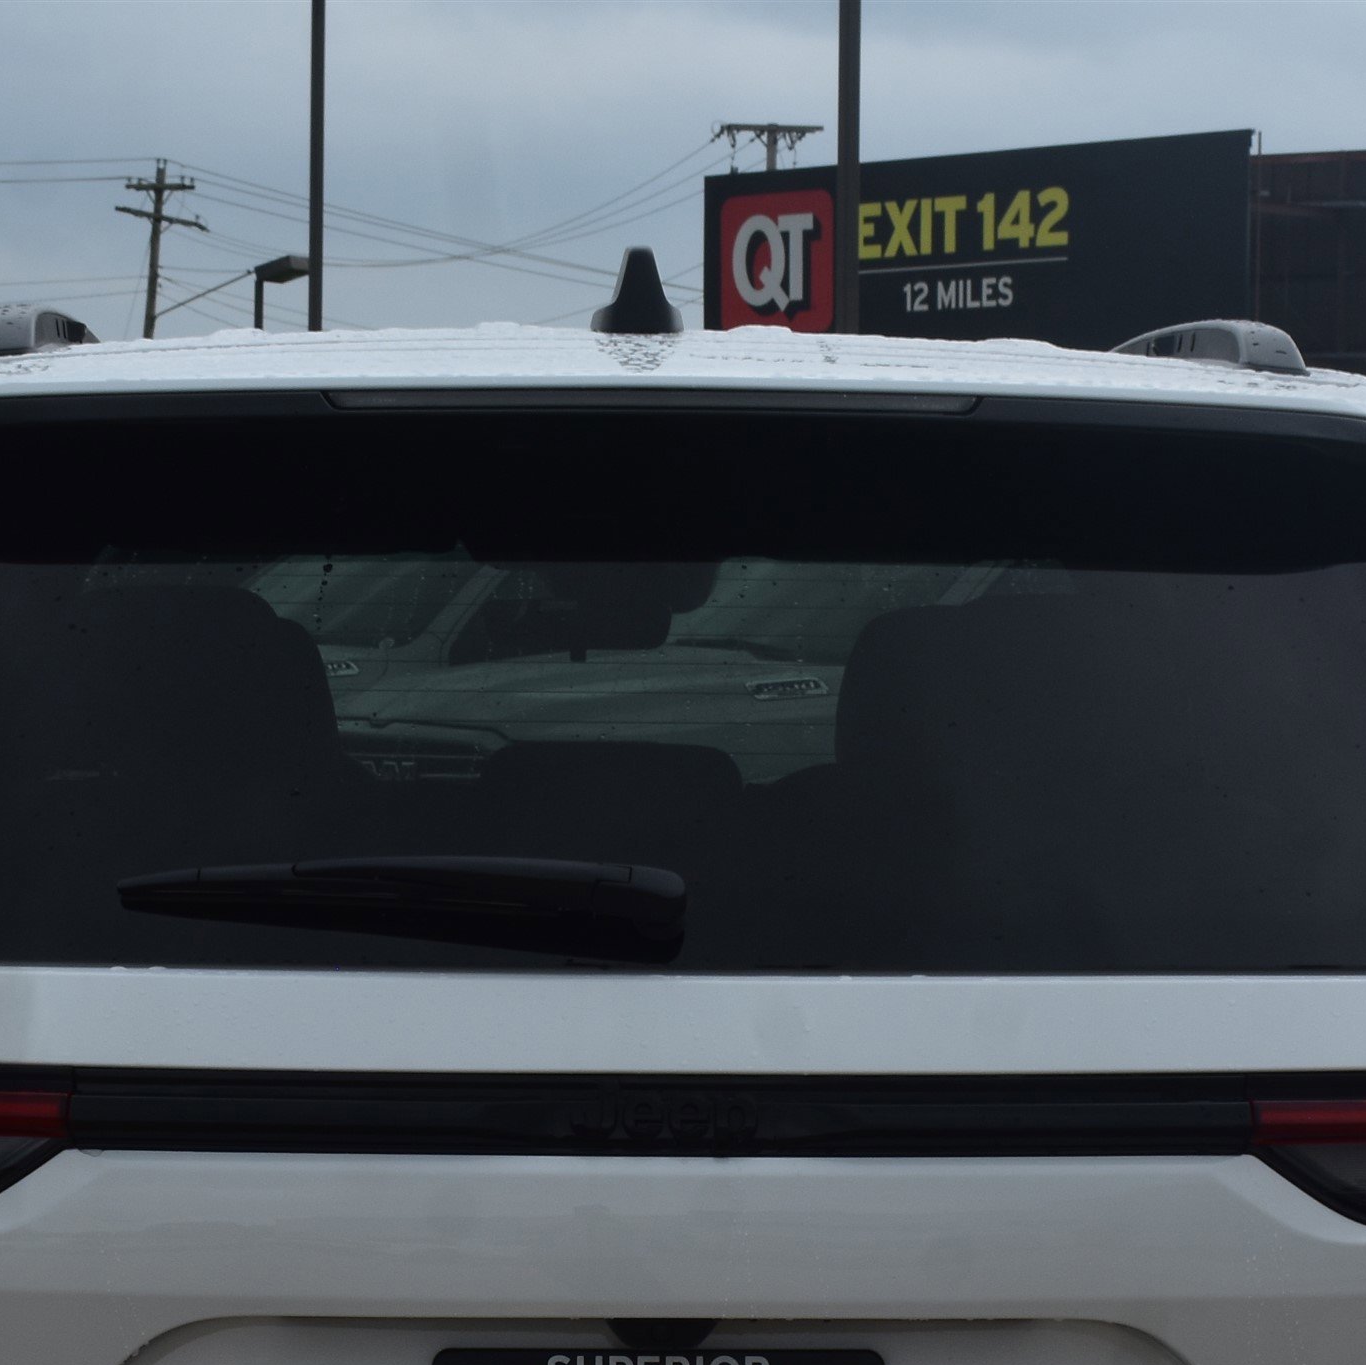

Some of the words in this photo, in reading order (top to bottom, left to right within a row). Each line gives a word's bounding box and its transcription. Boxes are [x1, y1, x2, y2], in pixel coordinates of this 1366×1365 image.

[858, 195, 967, 259] EXIT
[976, 186, 1070, 251] 142
[731, 211, 815, 312] QT
[903, 283, 929, 313] 12
[937, 276, 1014, 311] MILES
